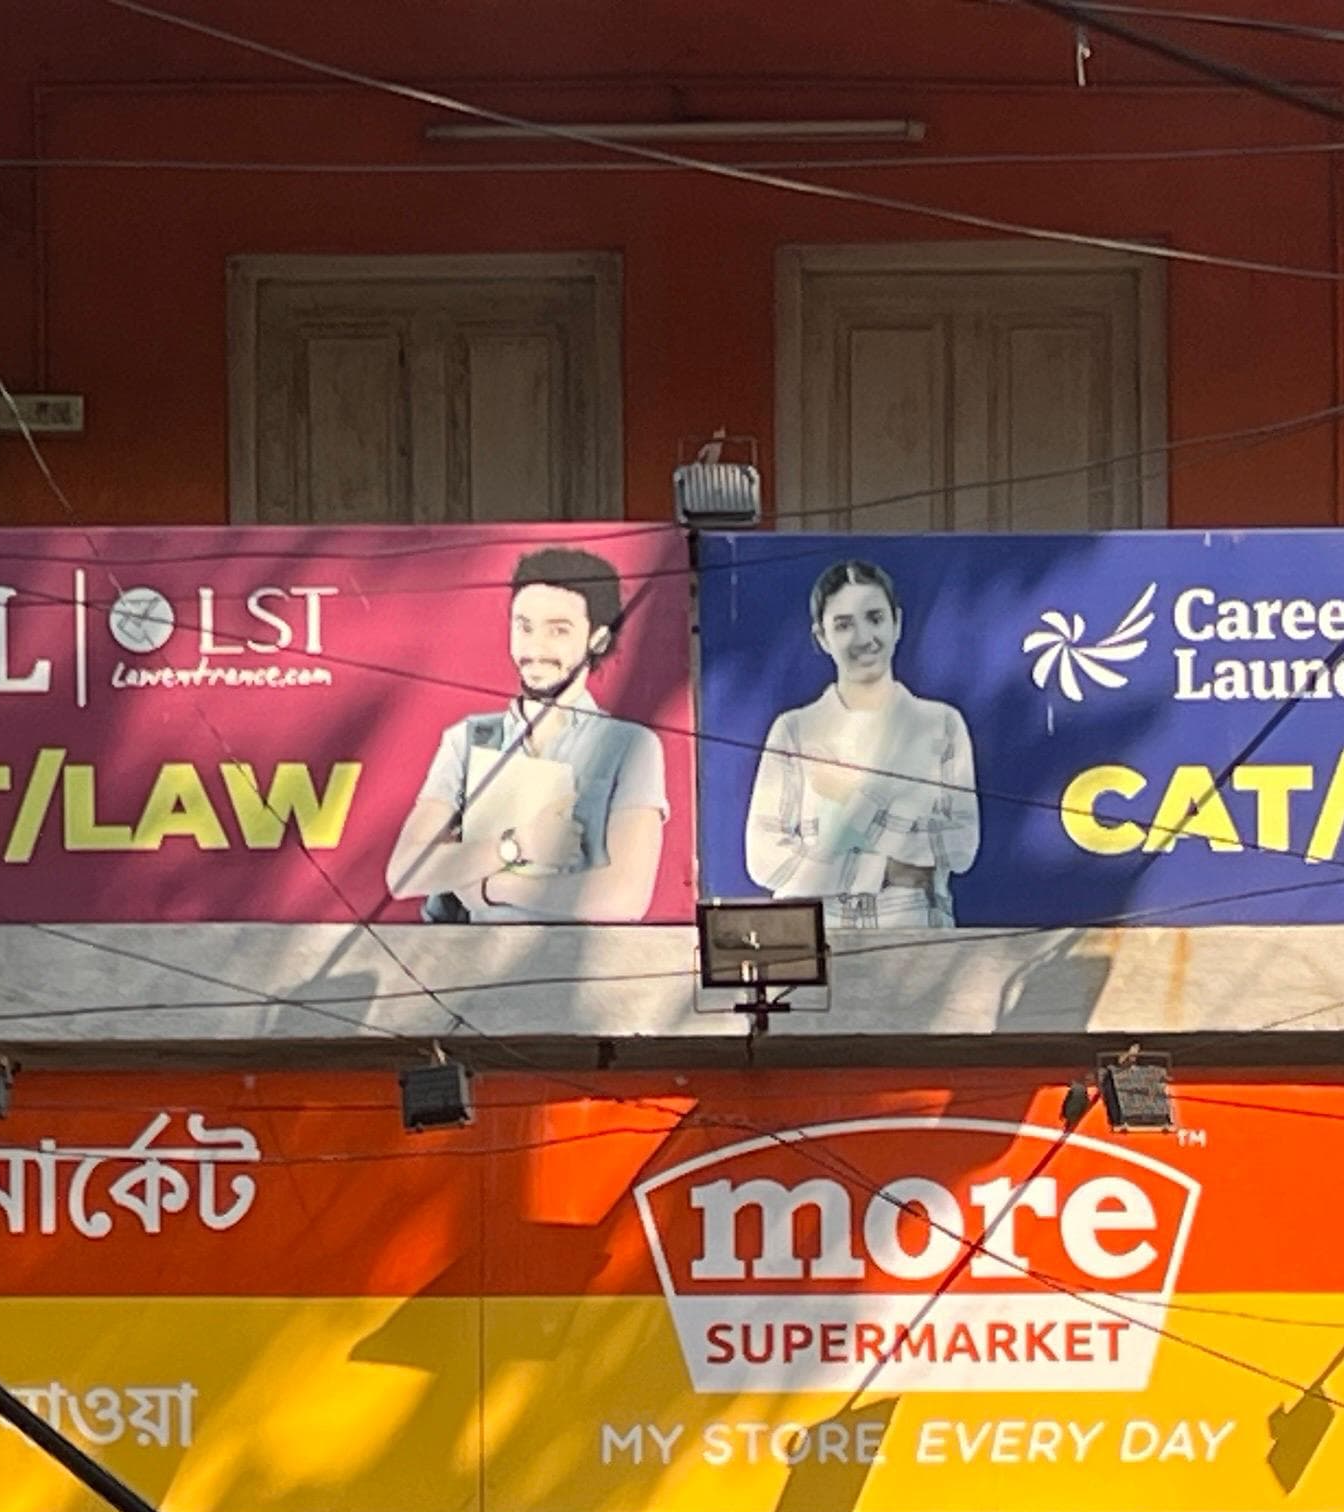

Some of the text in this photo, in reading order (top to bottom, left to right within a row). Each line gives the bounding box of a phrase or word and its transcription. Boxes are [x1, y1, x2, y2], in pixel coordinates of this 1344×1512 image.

[200, 586, 340, 656] LST
[689, 1173, 1159, 1281] more
[706, 1320, 1131, 1364] SUPERMARKET
[600, 1419, 1238, 1465] MY STORE EVERY DAY
